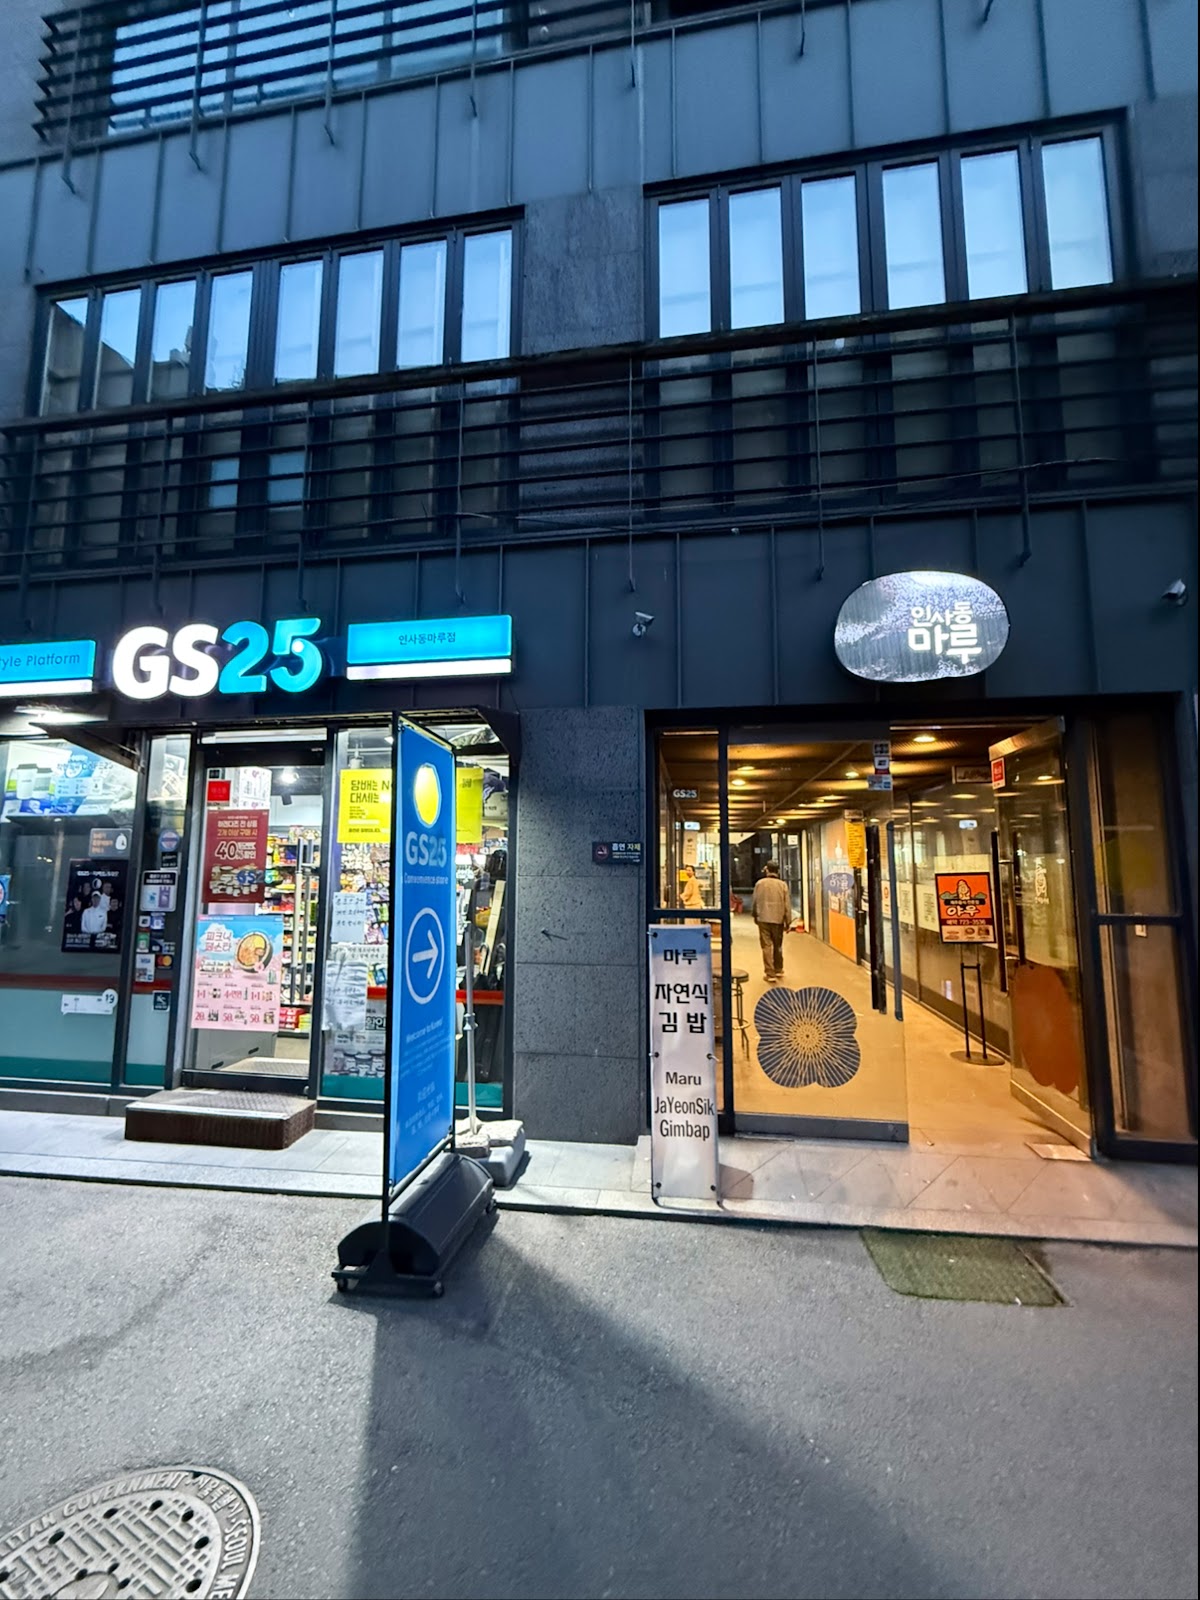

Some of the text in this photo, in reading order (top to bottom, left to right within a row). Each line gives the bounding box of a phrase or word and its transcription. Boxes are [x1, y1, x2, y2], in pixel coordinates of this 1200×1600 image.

[910, 601, 973, 627] 인사동
[398, 631, 456, 645] 인사동마루점
[908, 623, 982, 665] 마루
[26, 653, 80, 666] Platform
[112, 617, 323, 700] GS25
[351, 780, 378, 791] 담배는
[673, 789, 697, 798] GS25
[350, 793, 379, 803] 대세는
[405, 831, 447, 868] GS25
[404, 872, 435, 885] Convenience
[946, 905, 980, 917] 야우
[663, 948, 698, 965] 마루
[105, 994, 115, 1004] 19
[655, 983, 709, 1004] 자연식
[665, 1071, 702, 1086] Maru
[655, 1096, 715, 1116] JaYeonSik
[659, 1119, 711, 1141] Gimbap
[63, 1471, 189, 1517] GOVERNMENT
[221, 1519, 248, 1571] SEOUL
